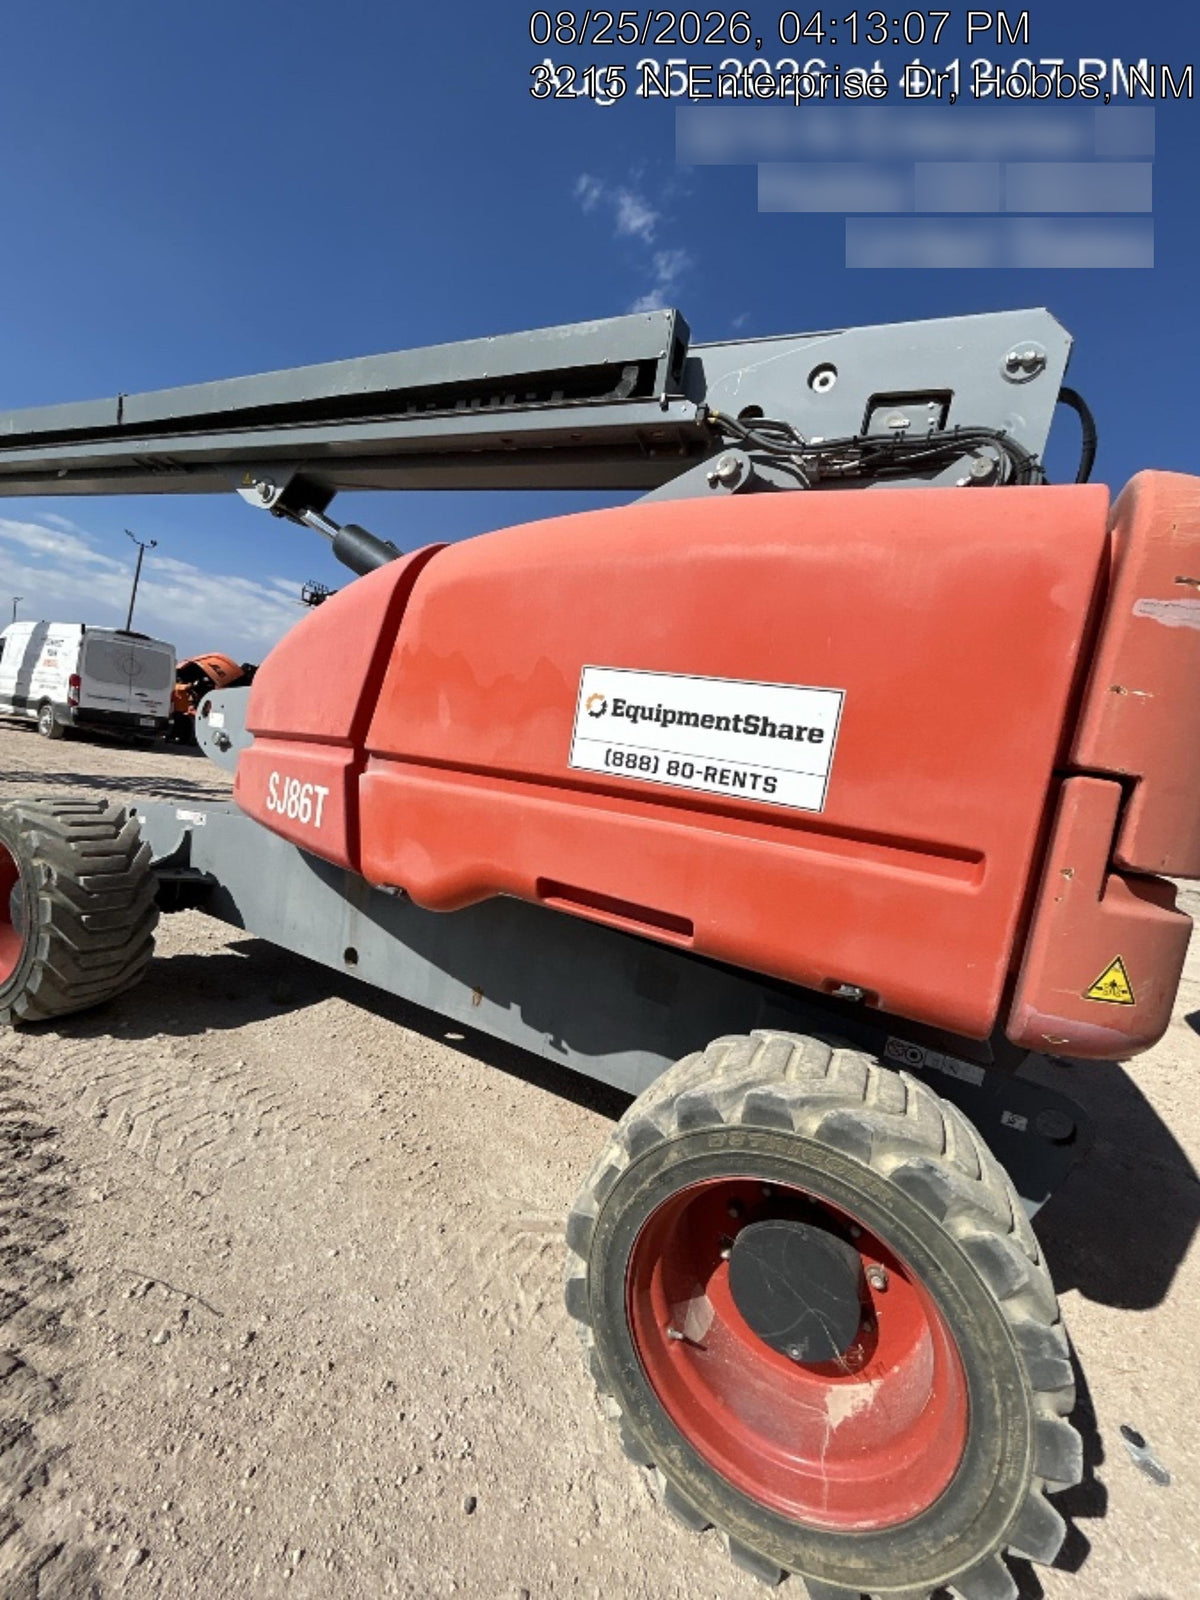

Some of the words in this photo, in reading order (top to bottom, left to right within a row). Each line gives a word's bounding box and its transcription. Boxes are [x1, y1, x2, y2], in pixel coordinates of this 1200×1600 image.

[611, 698, 825, 744] EquipmentShare
[604, 748, 660, 774] (888)
[666, 760, 778, 794] 80-RENTS
[266, 771, 329, 829] SJ86T
